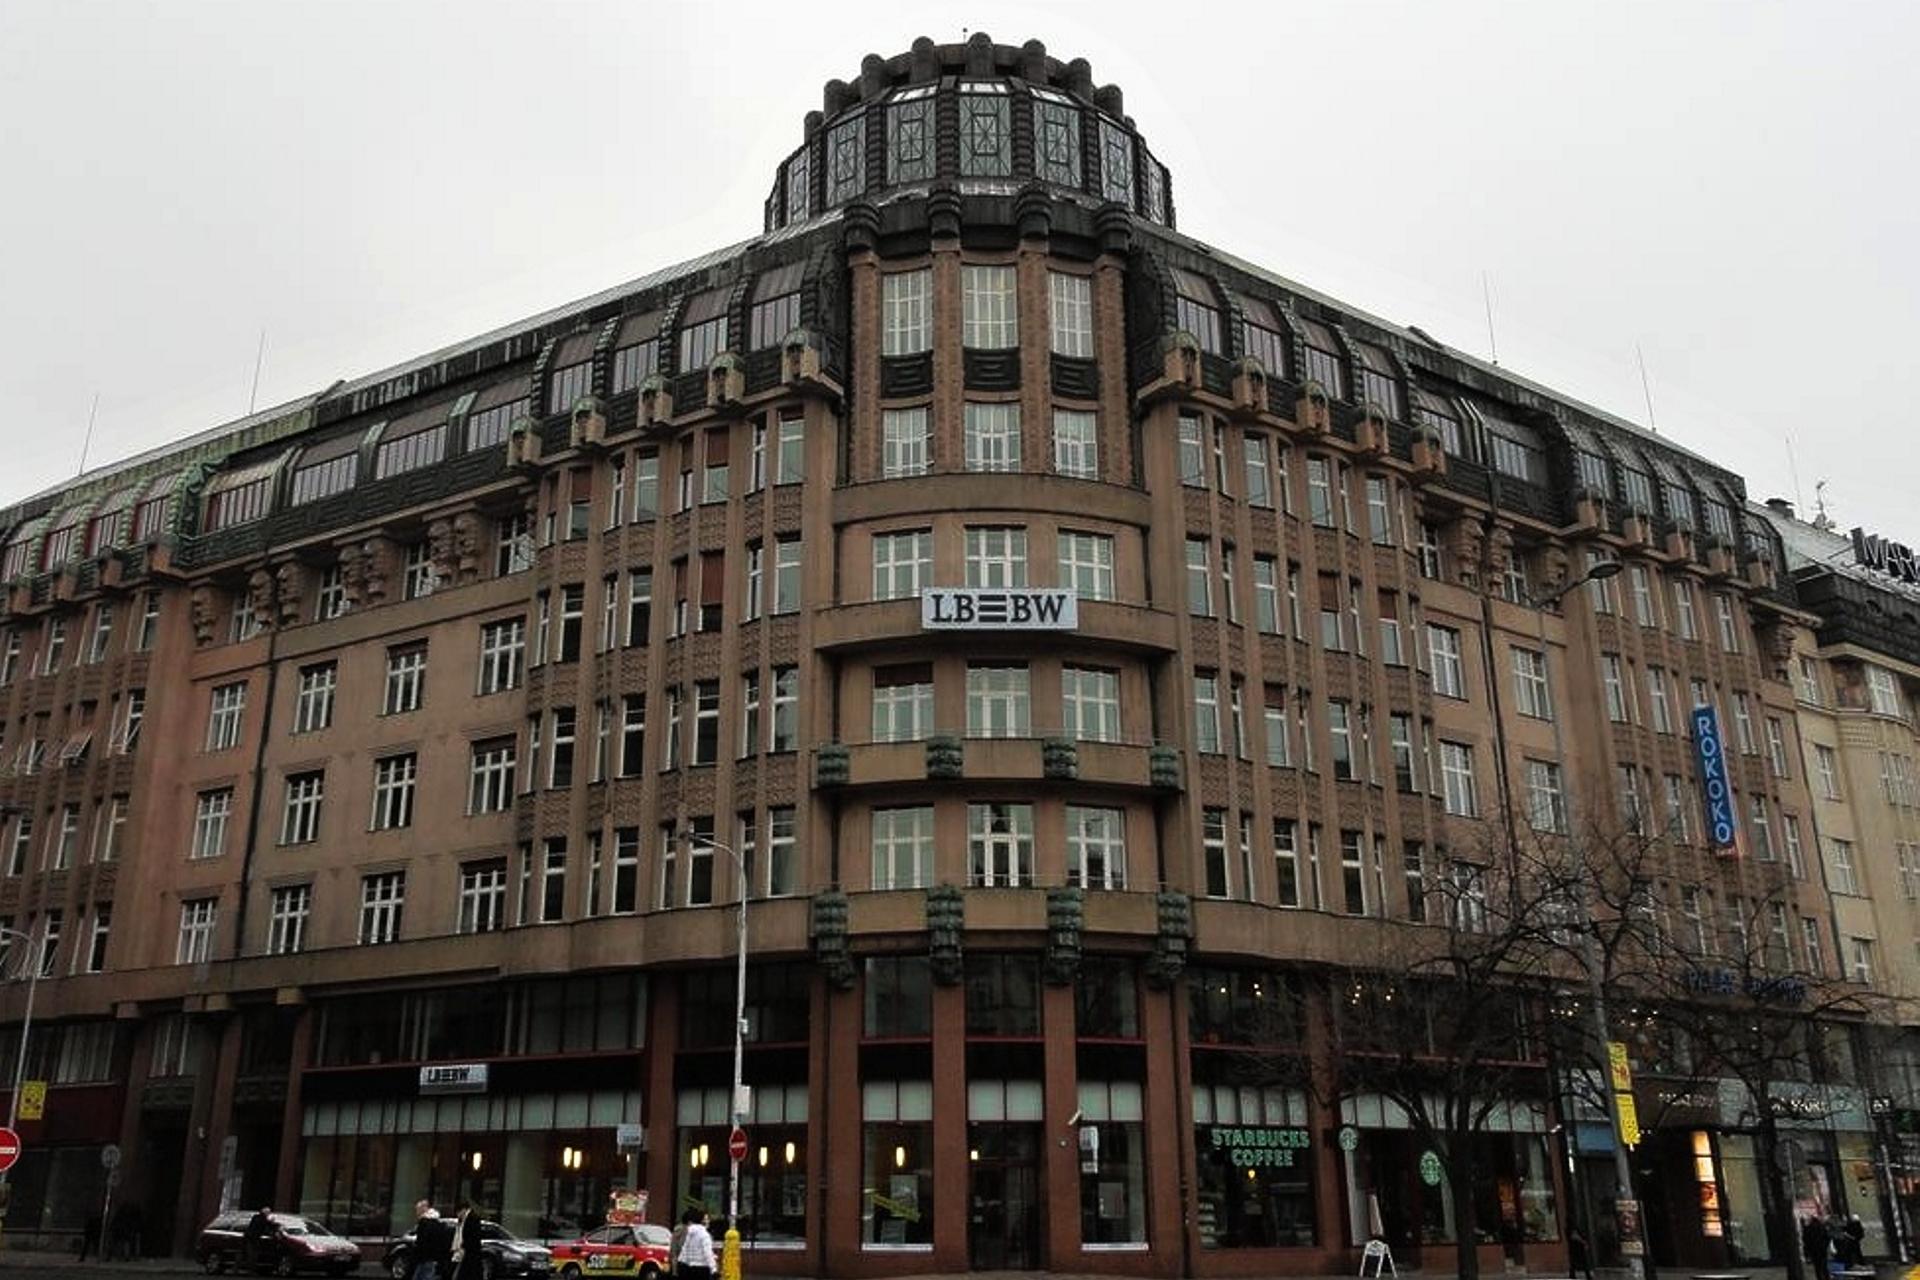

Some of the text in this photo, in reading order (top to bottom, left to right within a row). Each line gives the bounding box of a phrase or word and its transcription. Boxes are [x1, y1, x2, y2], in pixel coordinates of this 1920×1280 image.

[1697, 716, 1731, 843] ROKOKO
[1211, 1128, 1310, 1149] STARBUCKS
[1230, 1149, 1294, 1167] COFFEE
